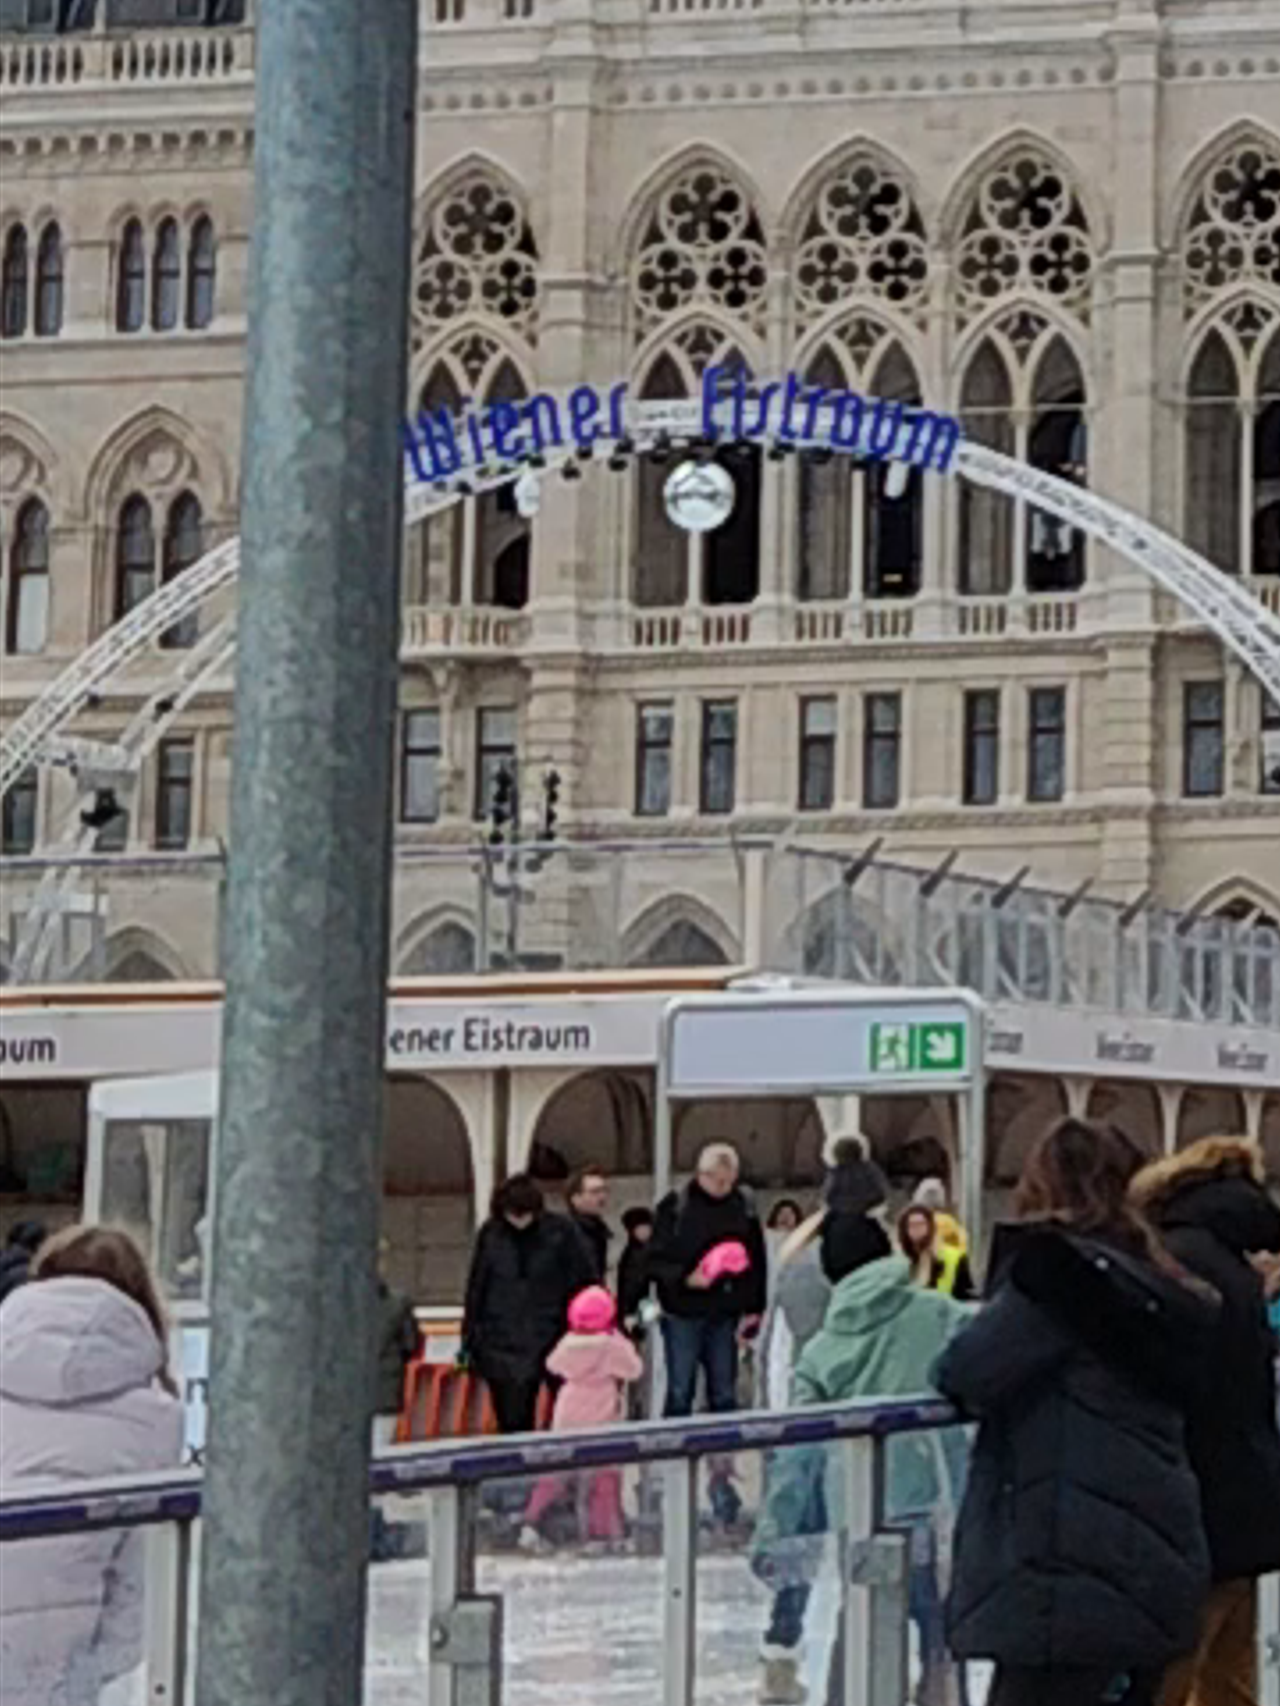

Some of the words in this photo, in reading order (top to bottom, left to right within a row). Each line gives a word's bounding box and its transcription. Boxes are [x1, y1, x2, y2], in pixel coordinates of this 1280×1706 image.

[404, 382, 628, 483] Wiener
[701, 366, 961, 473] Eistraum
[389, 1026, 455, 1055] ener
[463, 1016, 590, 1053] Eistraum
